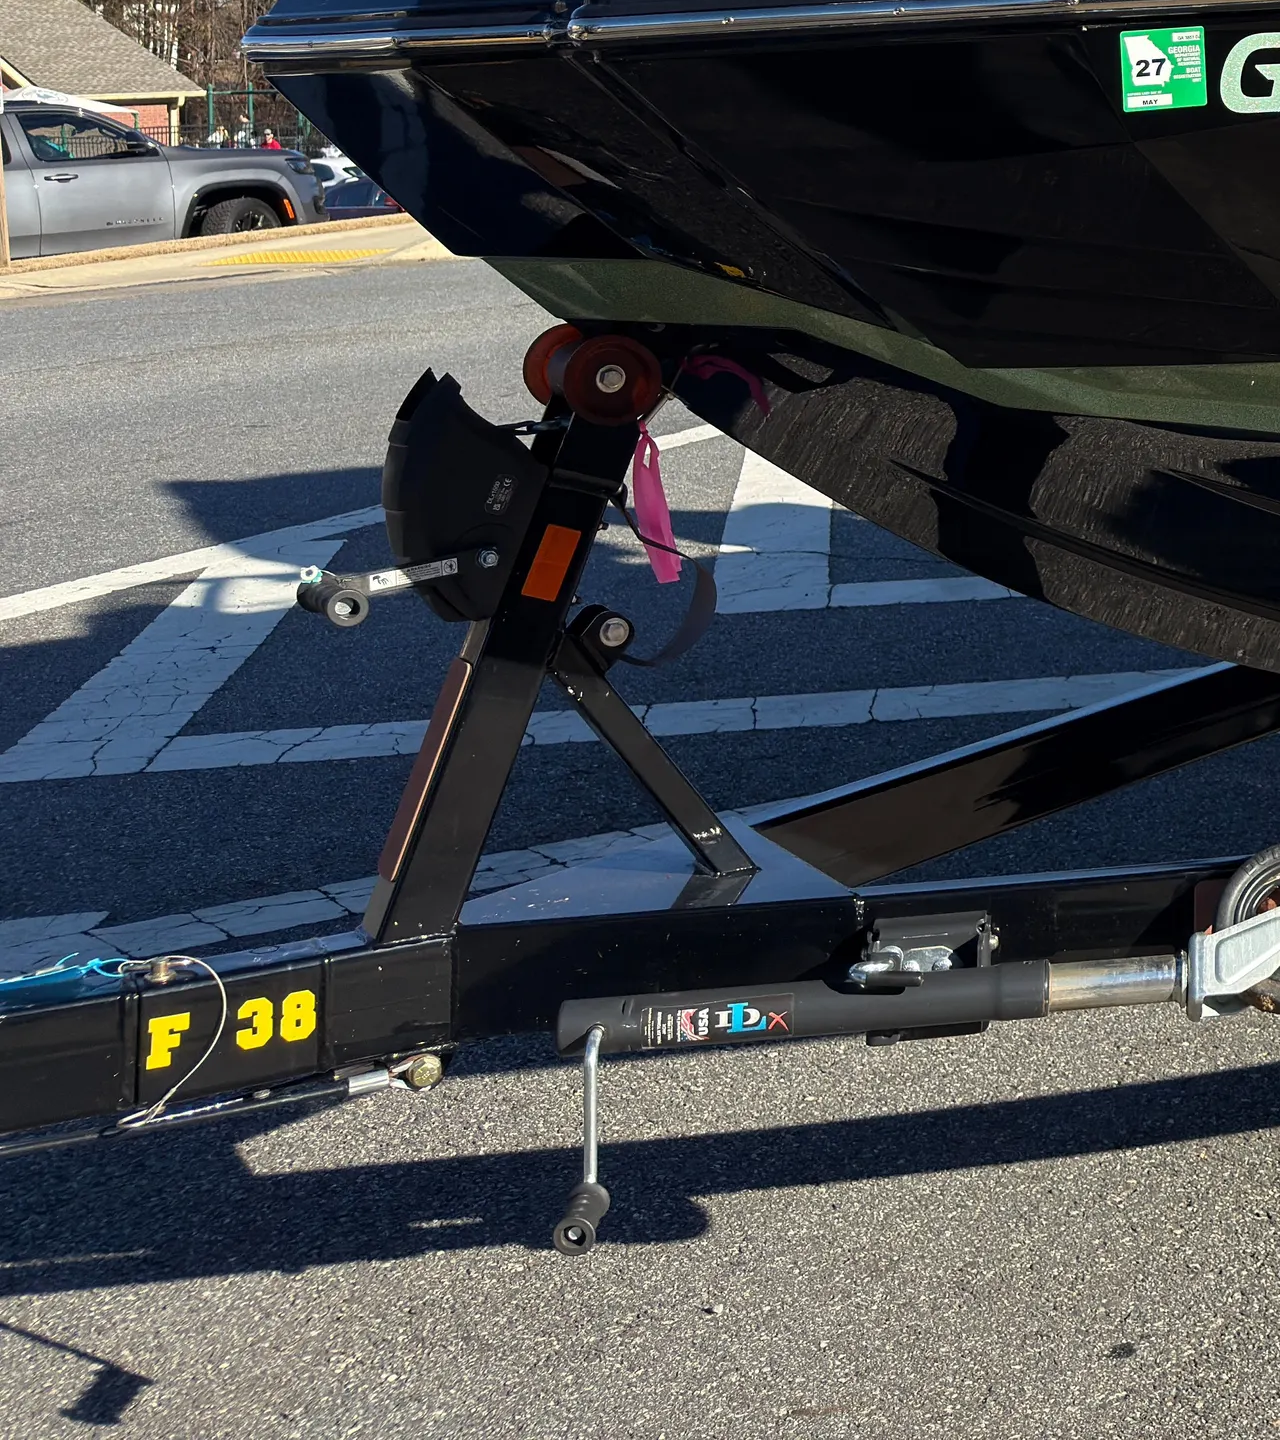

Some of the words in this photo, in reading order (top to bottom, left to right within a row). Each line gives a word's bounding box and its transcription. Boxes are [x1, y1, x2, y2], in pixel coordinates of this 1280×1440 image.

[1168, 44, 1201, 54] GEORGIA
[1135, 57, 1167, 78] 27
[145, 1011, 191, 1071] F
[235, 988, 318, 1051] 38
[697, 1007, 711, 1037] USA
